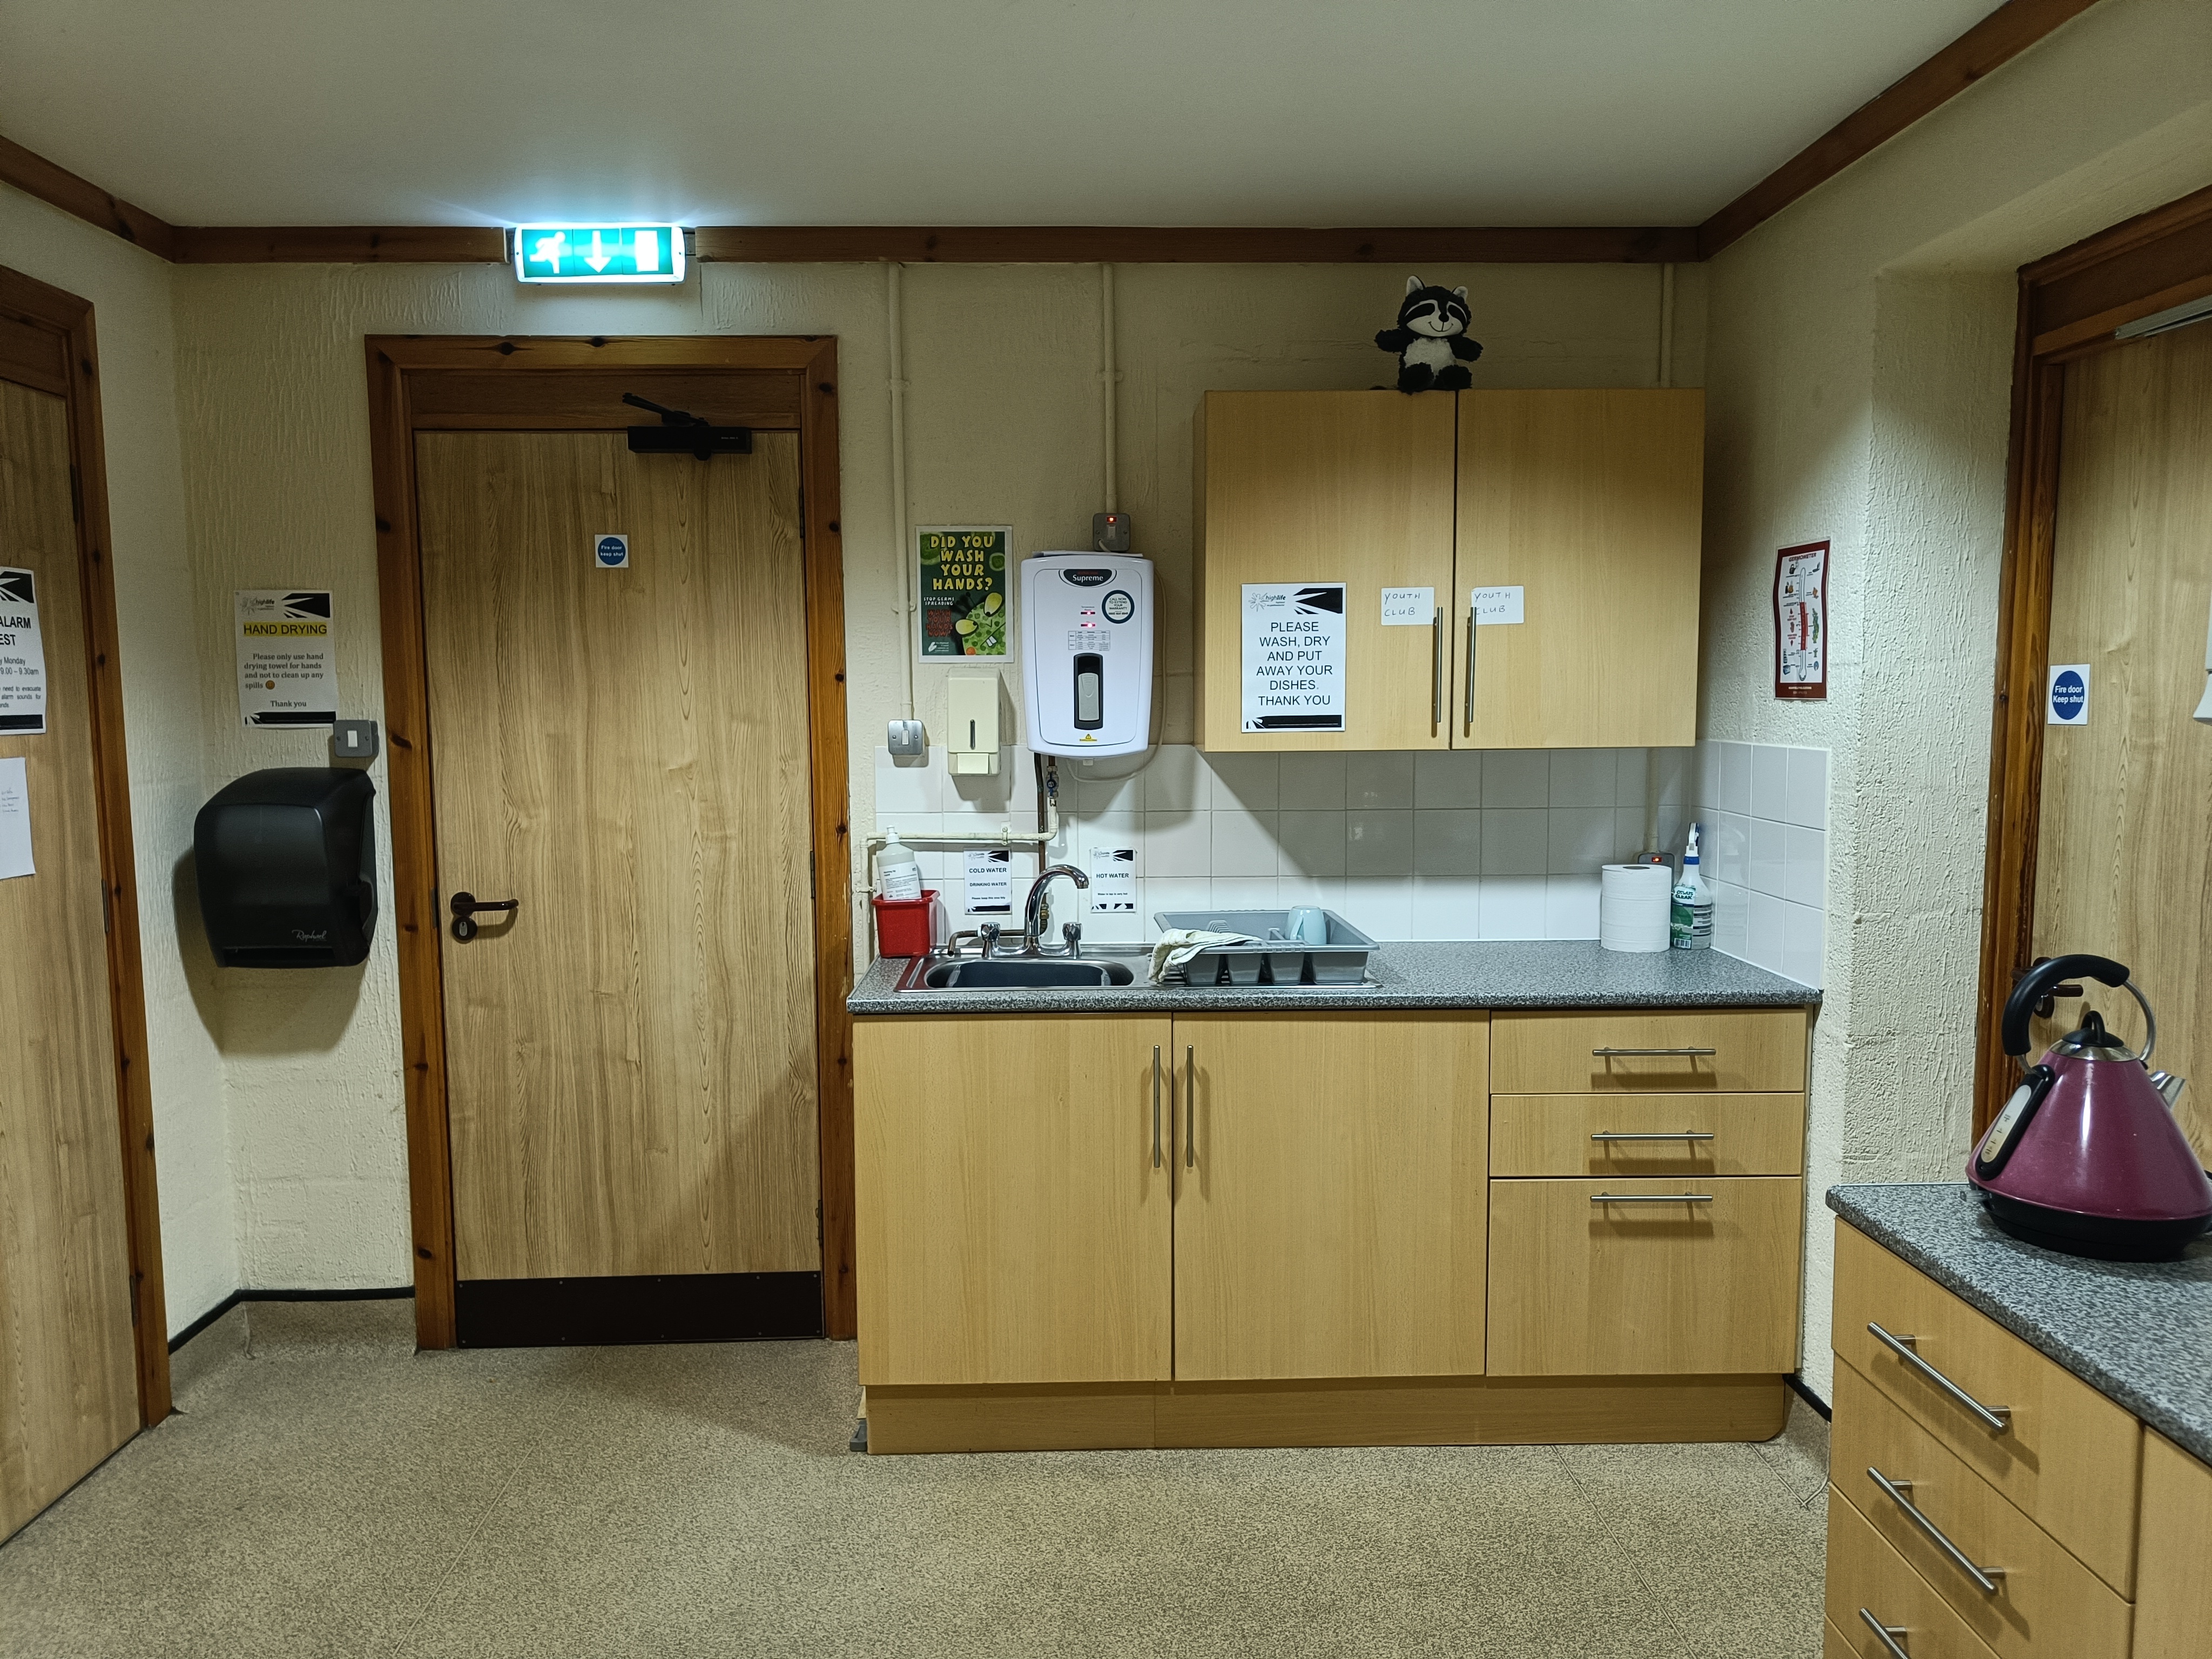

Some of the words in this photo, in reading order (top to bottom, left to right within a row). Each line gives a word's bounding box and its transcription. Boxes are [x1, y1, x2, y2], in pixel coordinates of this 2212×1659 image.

[930, 536, 956, 548] DID
[962, 535, 994, 548] YOU
[940, 550, 984, 562] WASH
[941, 564, 984, 576] YOUR
[1073, 574, 1104, 583] Supreme
[933, 577, 993, 591] HANDS?
[1384, 592, 1420, 605] YOUTH
[1474, 592, 1511, 603] YOUTH
[1384, 607, 1415, 617] CLUB
[244, 624, 278, 635] HAND
[281, 624, 327, 635] DRYING
[1271, 622, 1319, 632] PLEASE
[1259, 636, 1300, 648] WASH,
[1304, 636, 1331, 646] DRY
[276, 653, 292, 662] only
[1267, 651, 1293, 661] AND
[1297, 651, 1322, 660] PUT
[4, 657, 26, 666] Monday
[244, 662, 267, 671] drying
[0, 667, 13, 675] 9.00
[19, 667, 39, 676] 9.30am
[1256, 666, 1293, 676] AWAY
[1297, 665, 1333, 676] YOUR
[245, 681, 264, 690] spills
[1270, 680, 1319, 690] DISHES.
[2068, 685, 2083, 693] door
[1258, 696, 1300, 706] THANK
[1304, 695, 1331, 705] YOU
[2053, 695, 2069, 705] Keep
[292, 929, 327, 943] Raphael
